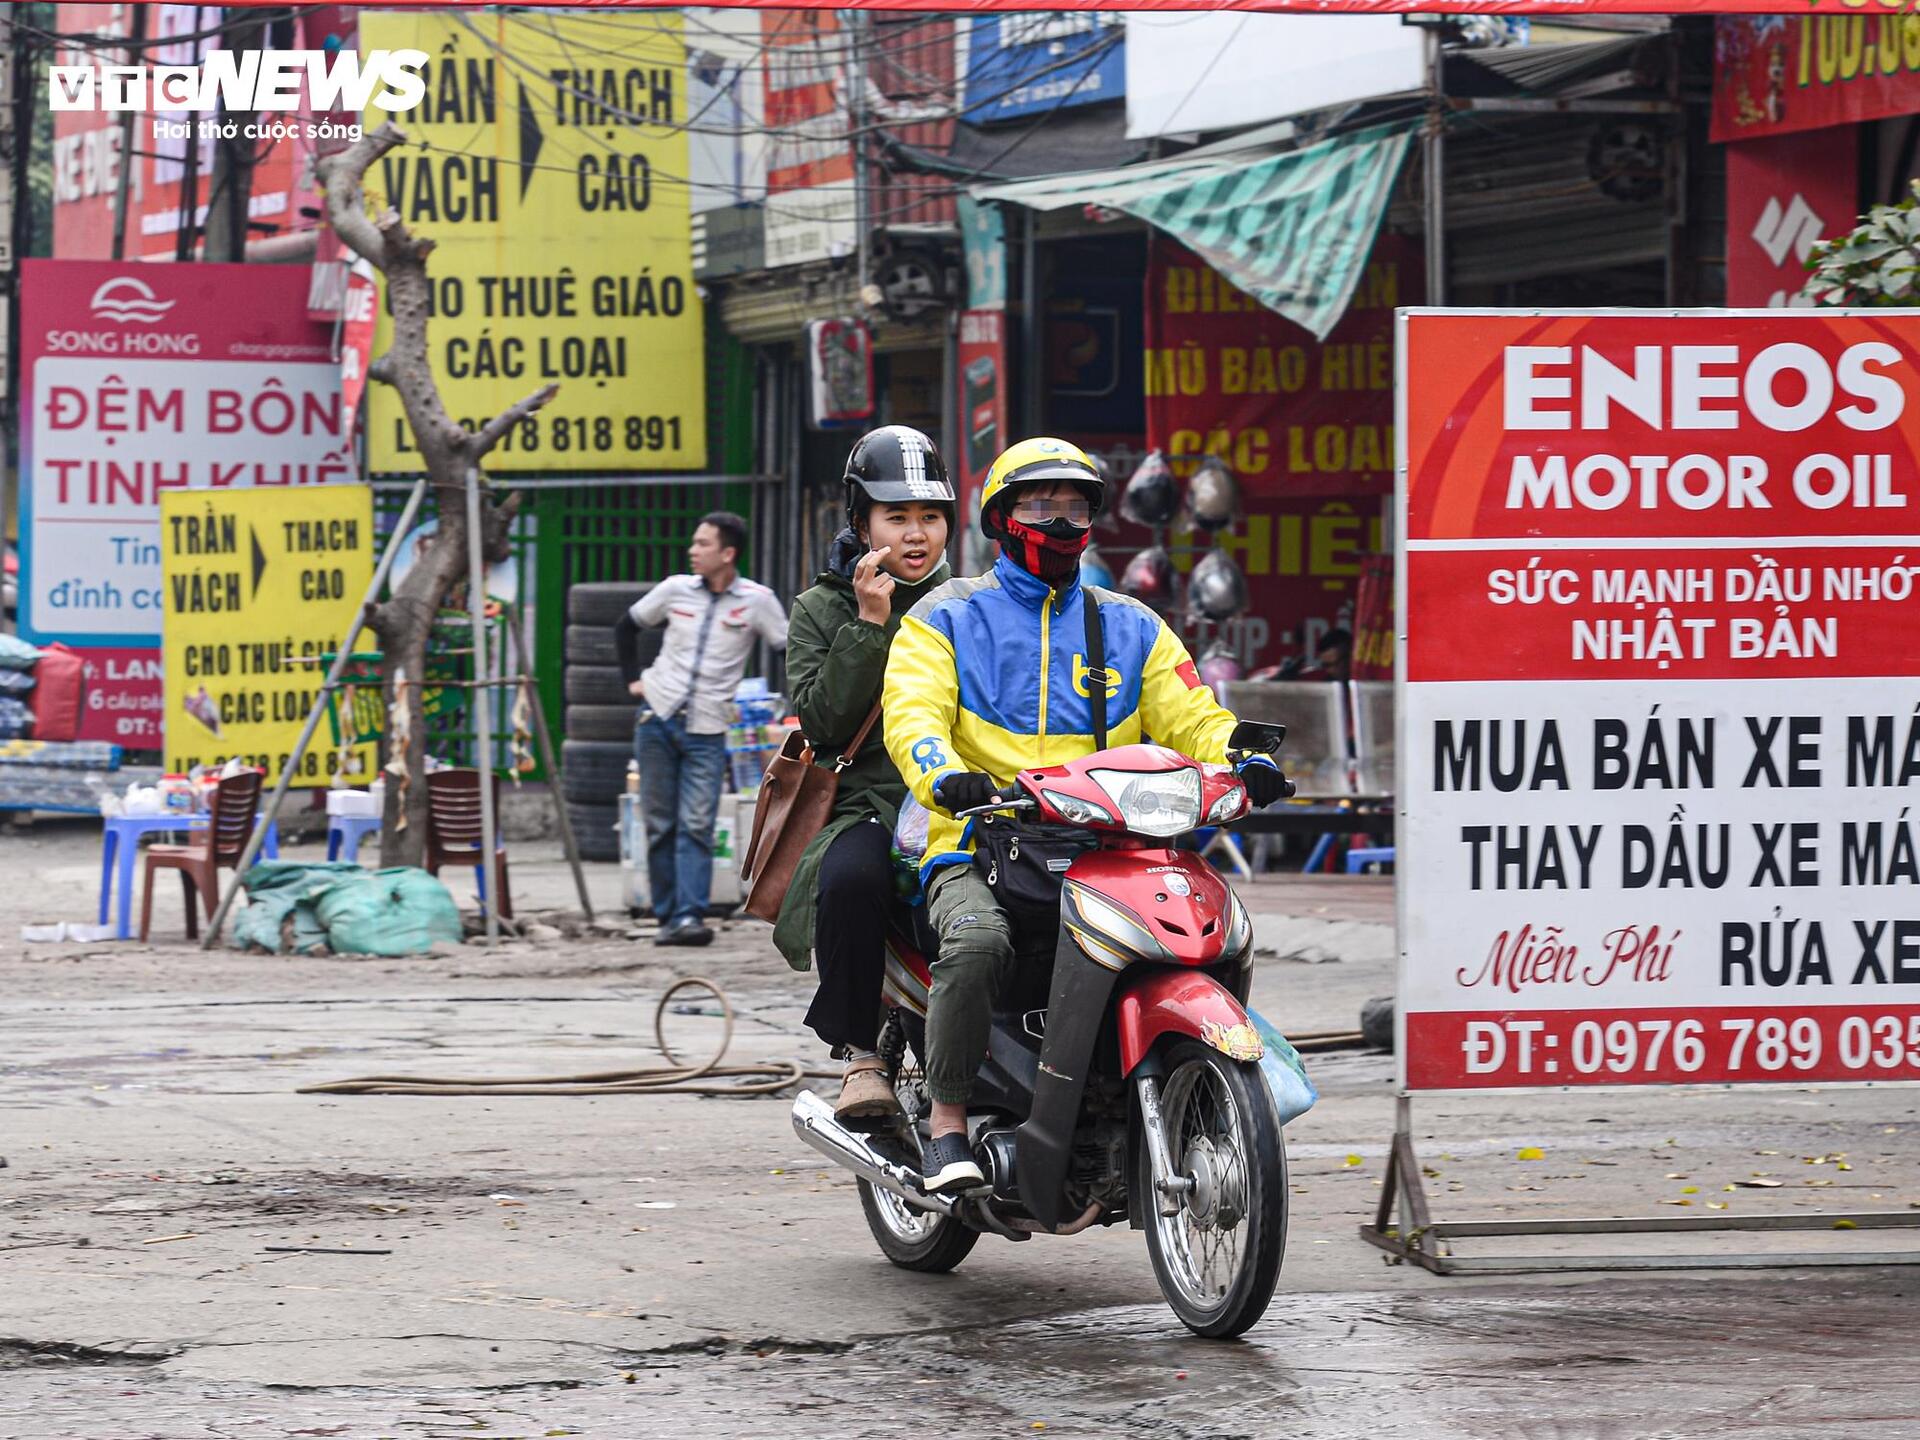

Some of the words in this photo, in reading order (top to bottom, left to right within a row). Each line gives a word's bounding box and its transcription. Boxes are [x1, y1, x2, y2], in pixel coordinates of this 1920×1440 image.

[550, 69, 673, 140] THẠCH
[382, 141, 498, 222] VÁCH
[577, 153, 652, 212] CAO
[478, 267, 578, 318] THUÊ
[591, 266, 685, 318] GIÁO
[46, 331, 119, 353] SONG
[123, 332, 200, 354] HONG
[445, 328, 525, 379] CÁC
[540, 336, 627, 387] LOẠI
[1220, 337, 1309, 394] BẢO
[1321, 328, 1391, 391] HIỂ
[45, 375, 184, 446] ĐỆM
[207, 377, 343, 437] BÔN
[1503, 342, 1906, 432] ENEOS
[552, 416, 613, 452] 818
[624, 416, 682, 451] 891
[1505, 453, 1773, 511] MOTOR
[1792, 453, 1908, 509] OIL
[110, 536, 160, 565] Tin
[48, 578, 122, 609] đỉnh
[170, 567, 242, 614] VÁCH
[300, 568, 345, 602] CAO
[1487, 556, 1580, 605] SỨC
[1591, 568, 1713, 611] MẠNH
[1725, 553, 1812, 603] DẦU
[184, 644, 230, 677] CHO
[237, 637, 294, 675] THUÊ
[1571, 607, 1717, 670] NHẬT
[1728, 604, 1839, 660] BẢN
[89, 688, 104, 710] 6
[220, 687, 265, 725] CÁC
[1432, 718, 1571, 793] MUA
[1593, 703, 1716, 791] BÁN
[1742, 715, 1823, 789] XE
[1846, 703, 1920, 788] MÁ
[1145, 865, 1191, 875] HONDA
[1460, 824, 1604, 891] THAY
[1620, 803, 1731, 890] DẦU
[1749, 822, 1821, 888] XE
[1841, 806, 1920, 887] MÁ
[1455, 923, 1579, 995] Miễn
[1582, 924, 1684, 988] Phí
[1720, 904, 1833, 987] RỬA
[1850, 919, 1920, 986] XE
[1461, 1020, 1561, 1075] ĐT:
[1570, 1018, 1707, 1074] 0976
[1720, 1017, 1823, 1072] 789
